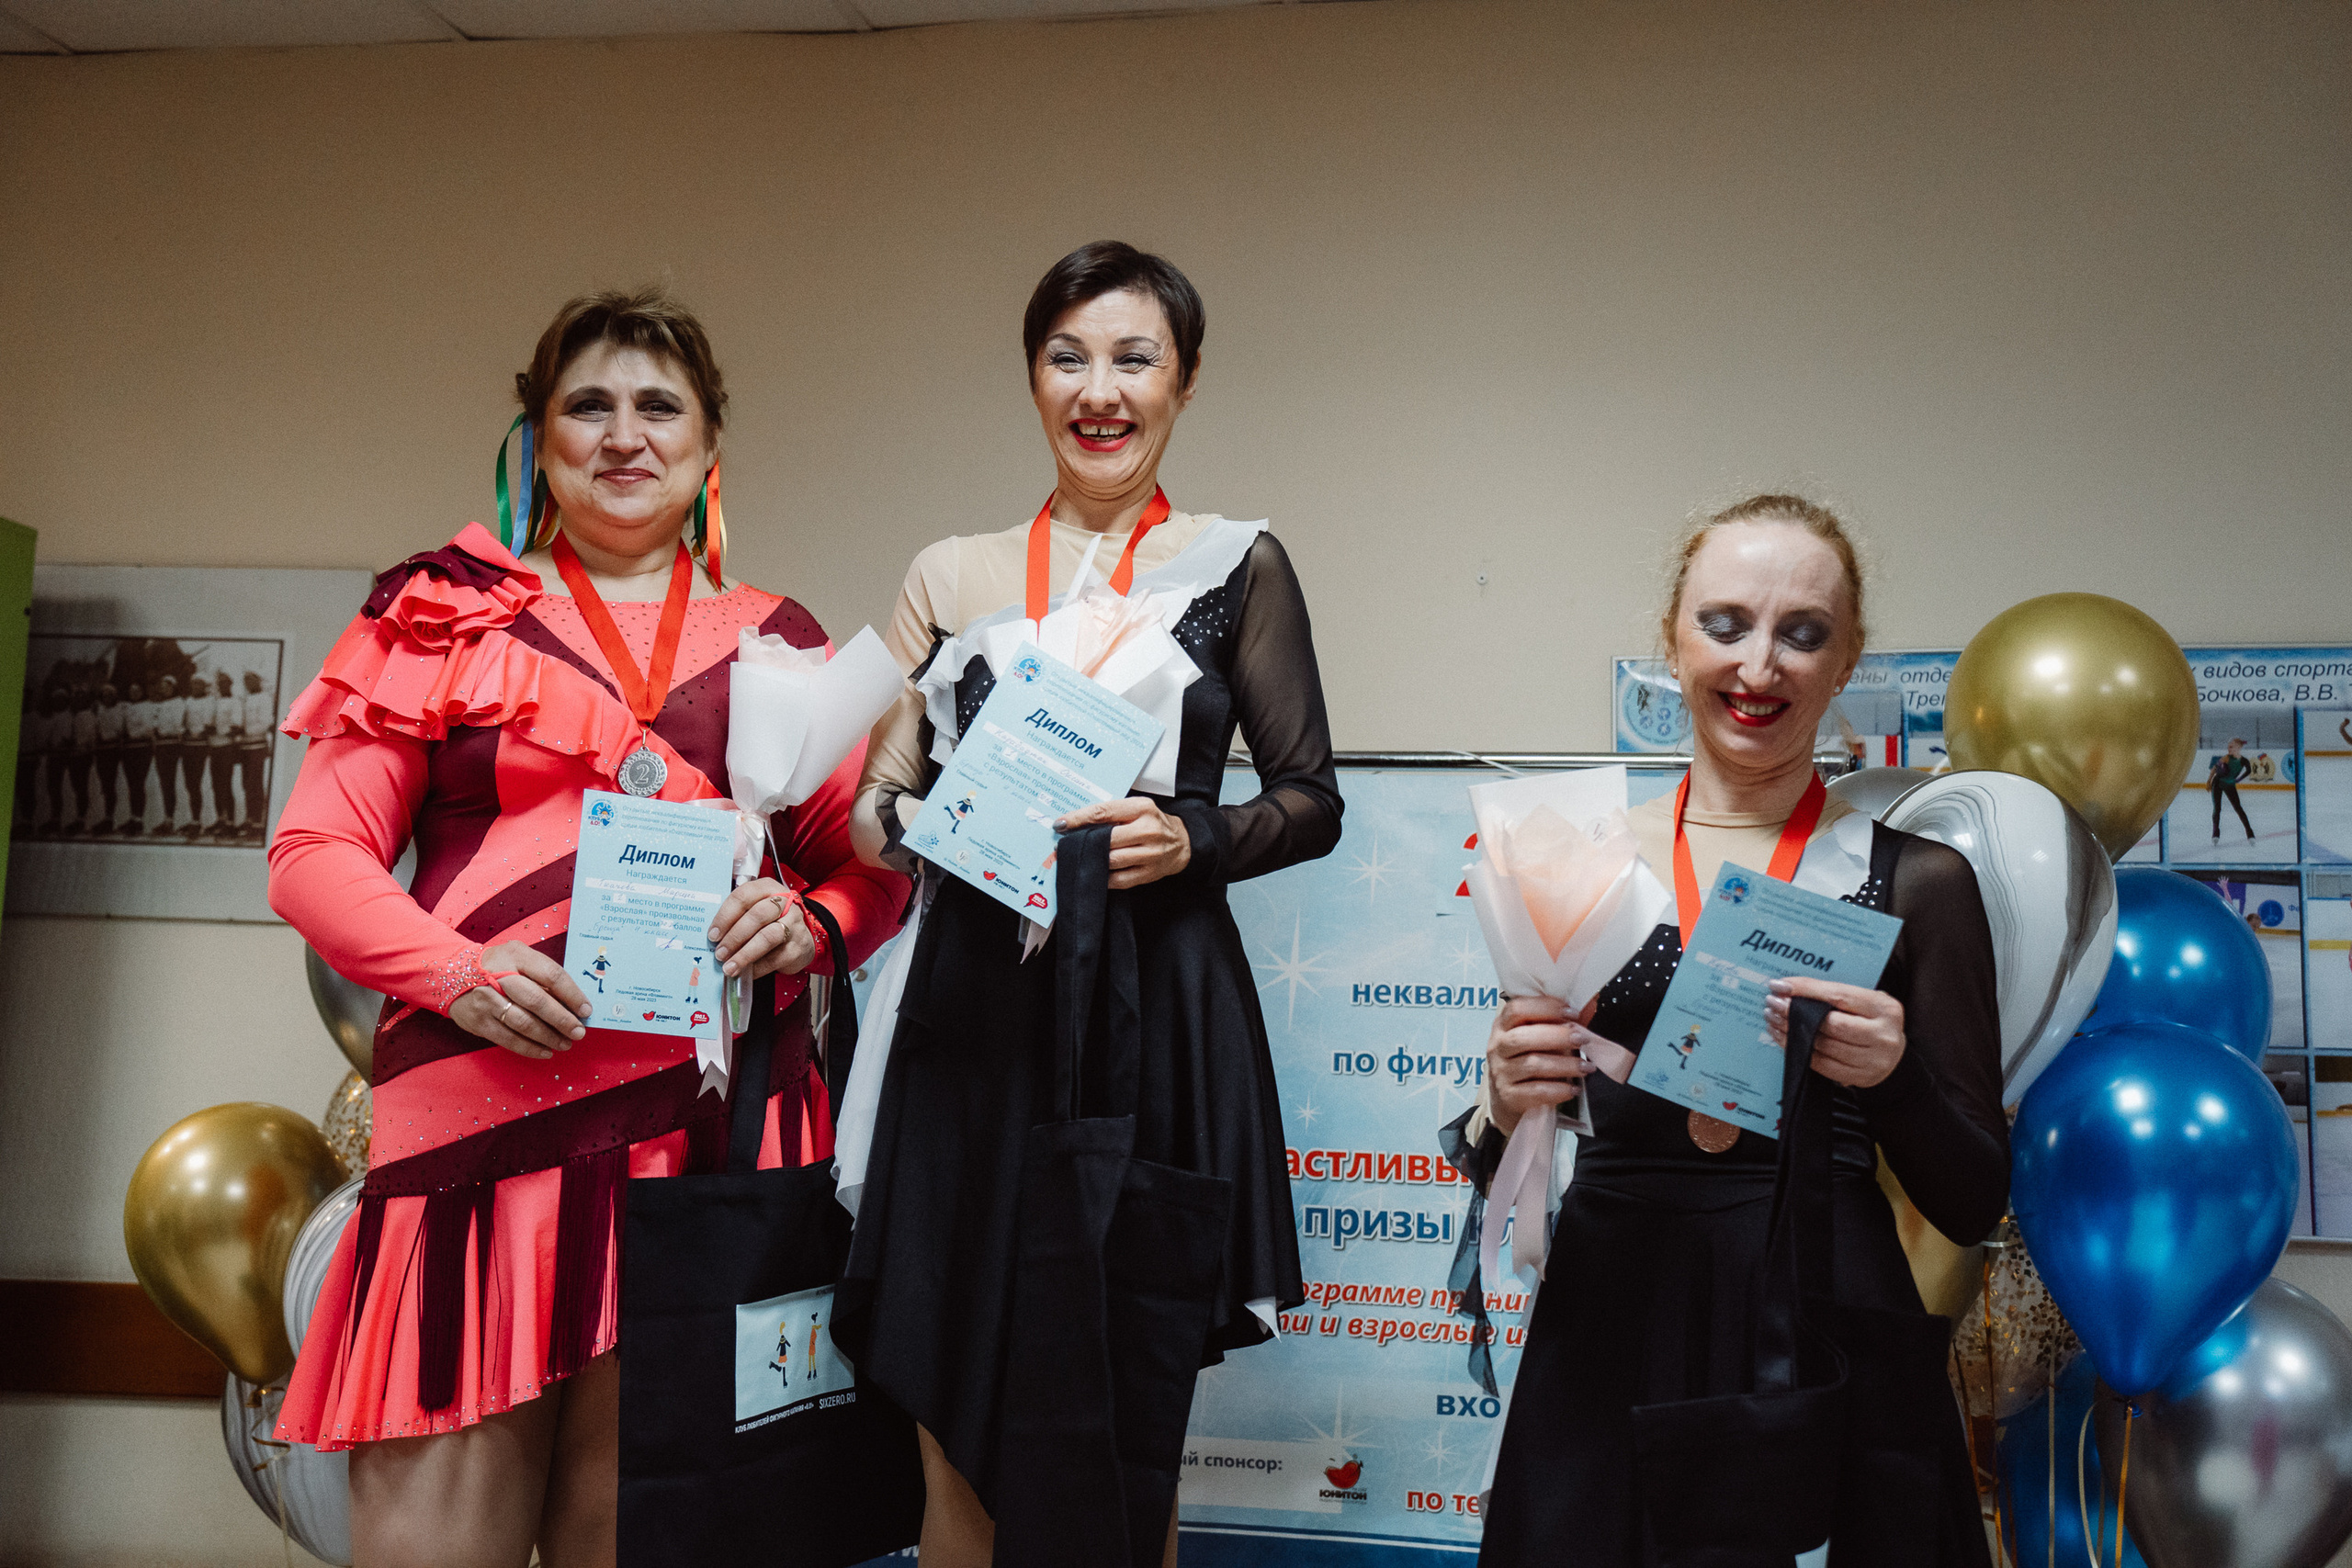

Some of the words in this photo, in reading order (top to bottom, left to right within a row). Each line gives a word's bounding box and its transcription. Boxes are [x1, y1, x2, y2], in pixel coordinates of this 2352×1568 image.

[1850, 671, 1888, 684] ены
[1900, 667, 1951, 683] отде
[2203, 661, 2267, 679] видов
[2274, 663, 2352, 680] спорта
[1907, 690, 1944, 708] Тре
[2198, 685, 2286, 704] Бочкова,
[2295, 684, 2338, 701] В.В.
[1024, 708, 1102, 758] Диплом
[1026, 730, 1085, 770] Награждается
[636, 763, 650, 784] 2
[988, 752, 1031, 781] «Взрослая»
[1030, 776, 1082, 812] произвольна
[992, 743, 1003, 753] за
[1017, 758, 1041, 775] место
[1047, 776, 1091, 804] программе
[989, 765, 1039, 797] результатом
[1050, 799, 1071, 816] балл
[618, 844, 695, 869] Диплом
[626, 869, 687, 884] Награждается
[995, 877, 1020, 894] ЮНИТОН
[600, 903, 649, 917] «Взрослая»
[649, 910, 706, 923] произвольная
[628, 897, 653, 907] место
[662, 902, 706, 913] программе
[607, 916, 661, 927] результатом
[673, 922, 702, 932] баллов
[1739, 929, 1834, 972] Диплом
[1352, 983, 1498, 1008] неквали
[1708, 994, 1768, 1024] результато
[1333, 1053, 1376, 1073] по
[1387, 1046, 1487, 1085] фигур
[1286, 1148, 1470, 1182] астливы
[1304, 1207, 1452, 1247] призы
[1302, 1282, 1422, 1307] ограмме
[1319, 1317, 1338, 1334] и
[819, 1392, 856, 1410] SIXZERO.RU
[1436, 1394, 1501, 1418] вхо
[1204, 1456, 1283, 1474] спонсор:
[1319, 1489, 1367, 1500] ЮНИТОН
[1408, 1491, 1443, 1510] по
[1453, 1495, 1481, 1514] те
